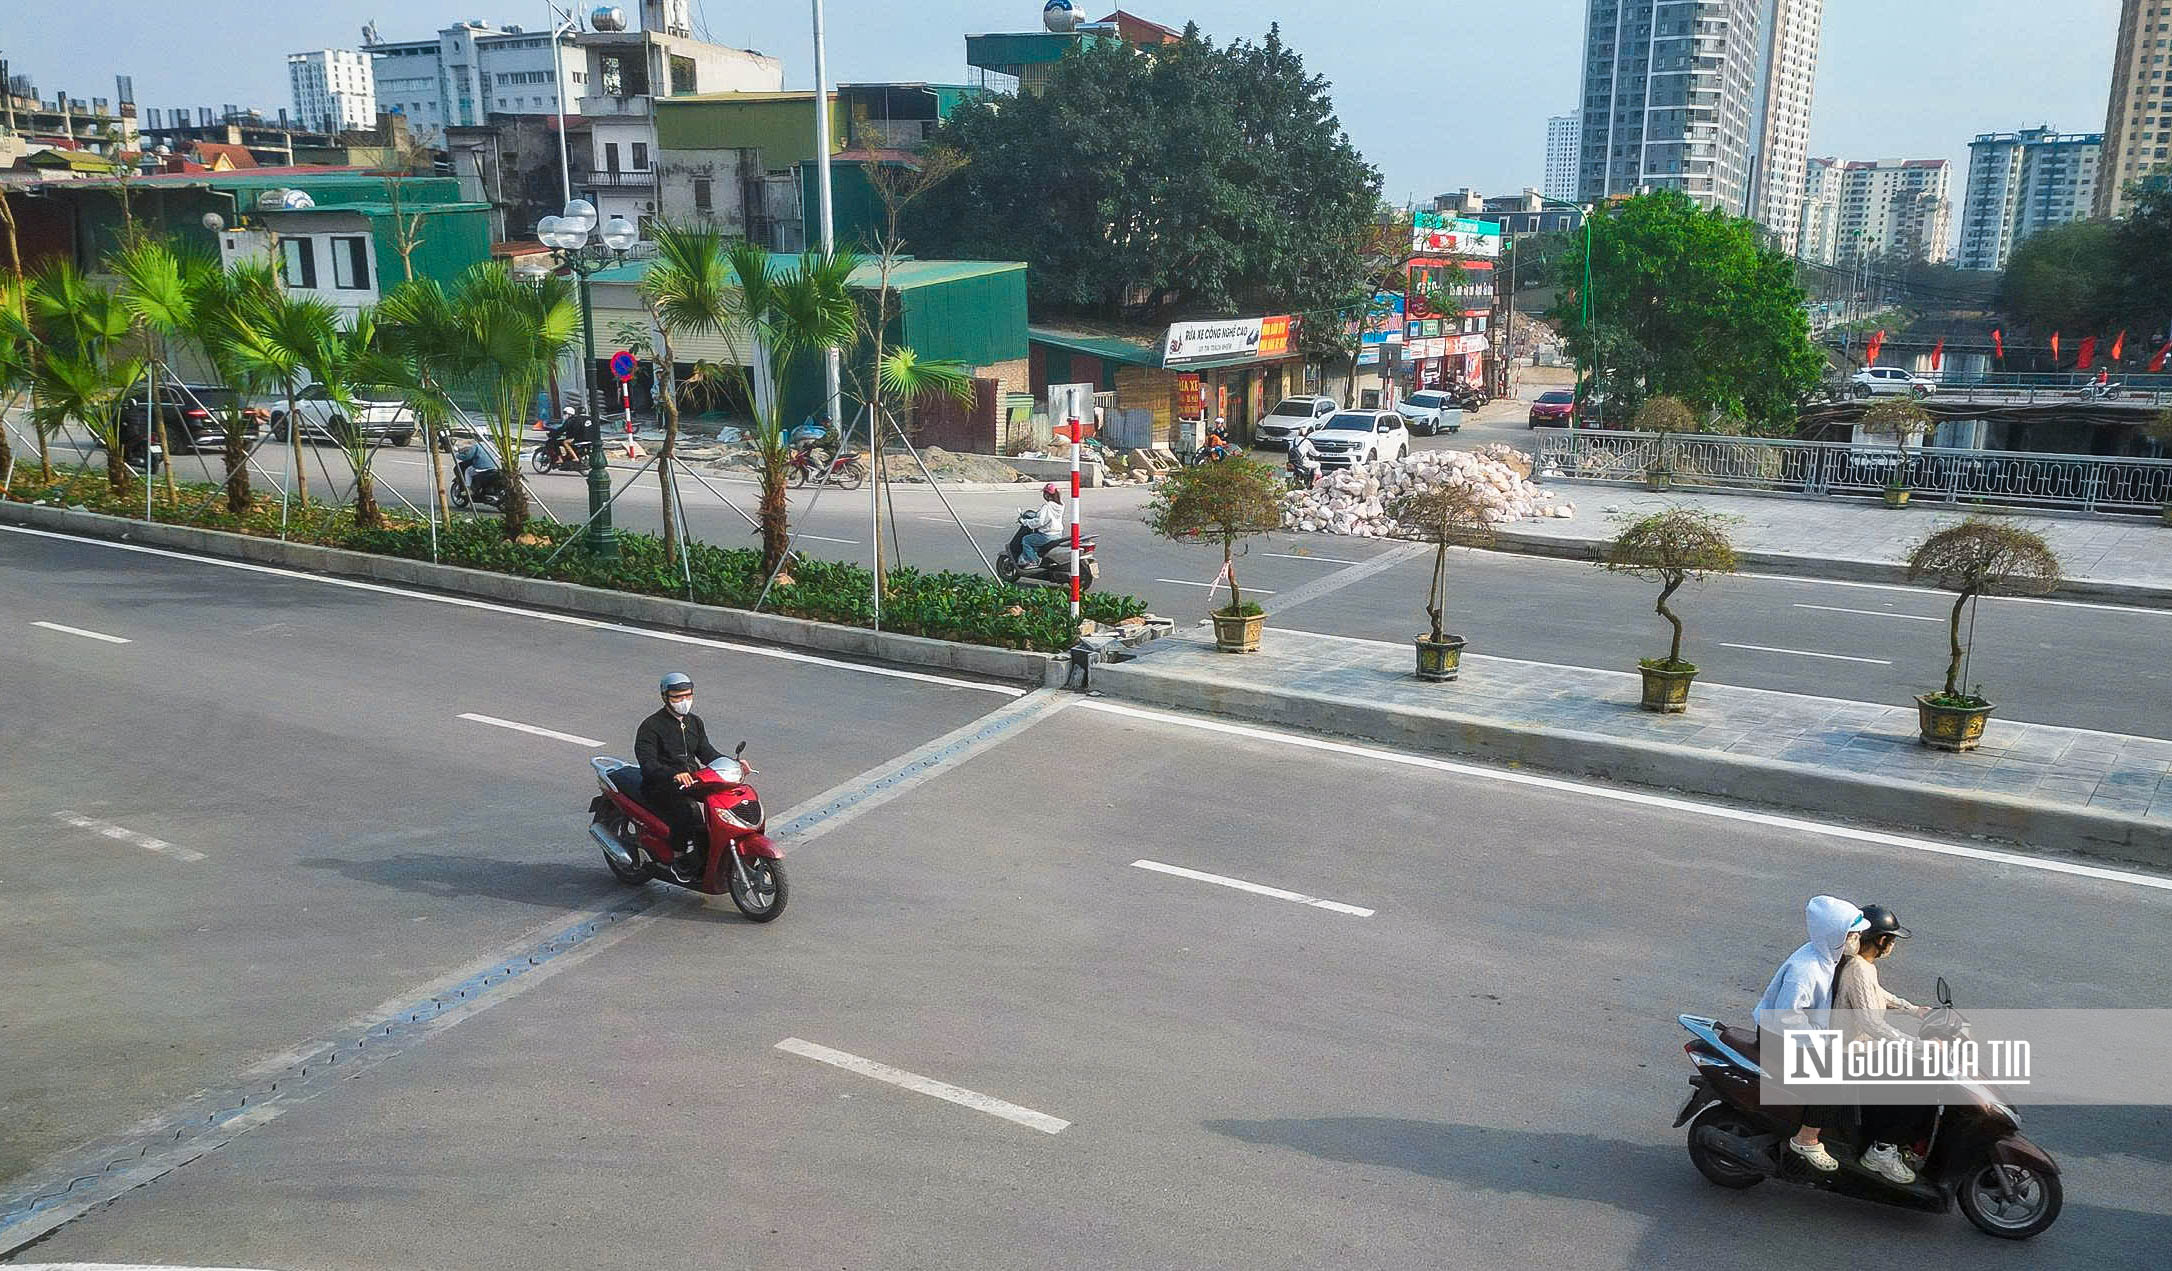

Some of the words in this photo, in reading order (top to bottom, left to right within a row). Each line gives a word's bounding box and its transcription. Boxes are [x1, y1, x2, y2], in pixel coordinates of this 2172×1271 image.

[1197, 328, 1204, 340] XE
[1204, 325, 1221, 340] CÔNG
[1237, 326, 1248, 337] CAO
